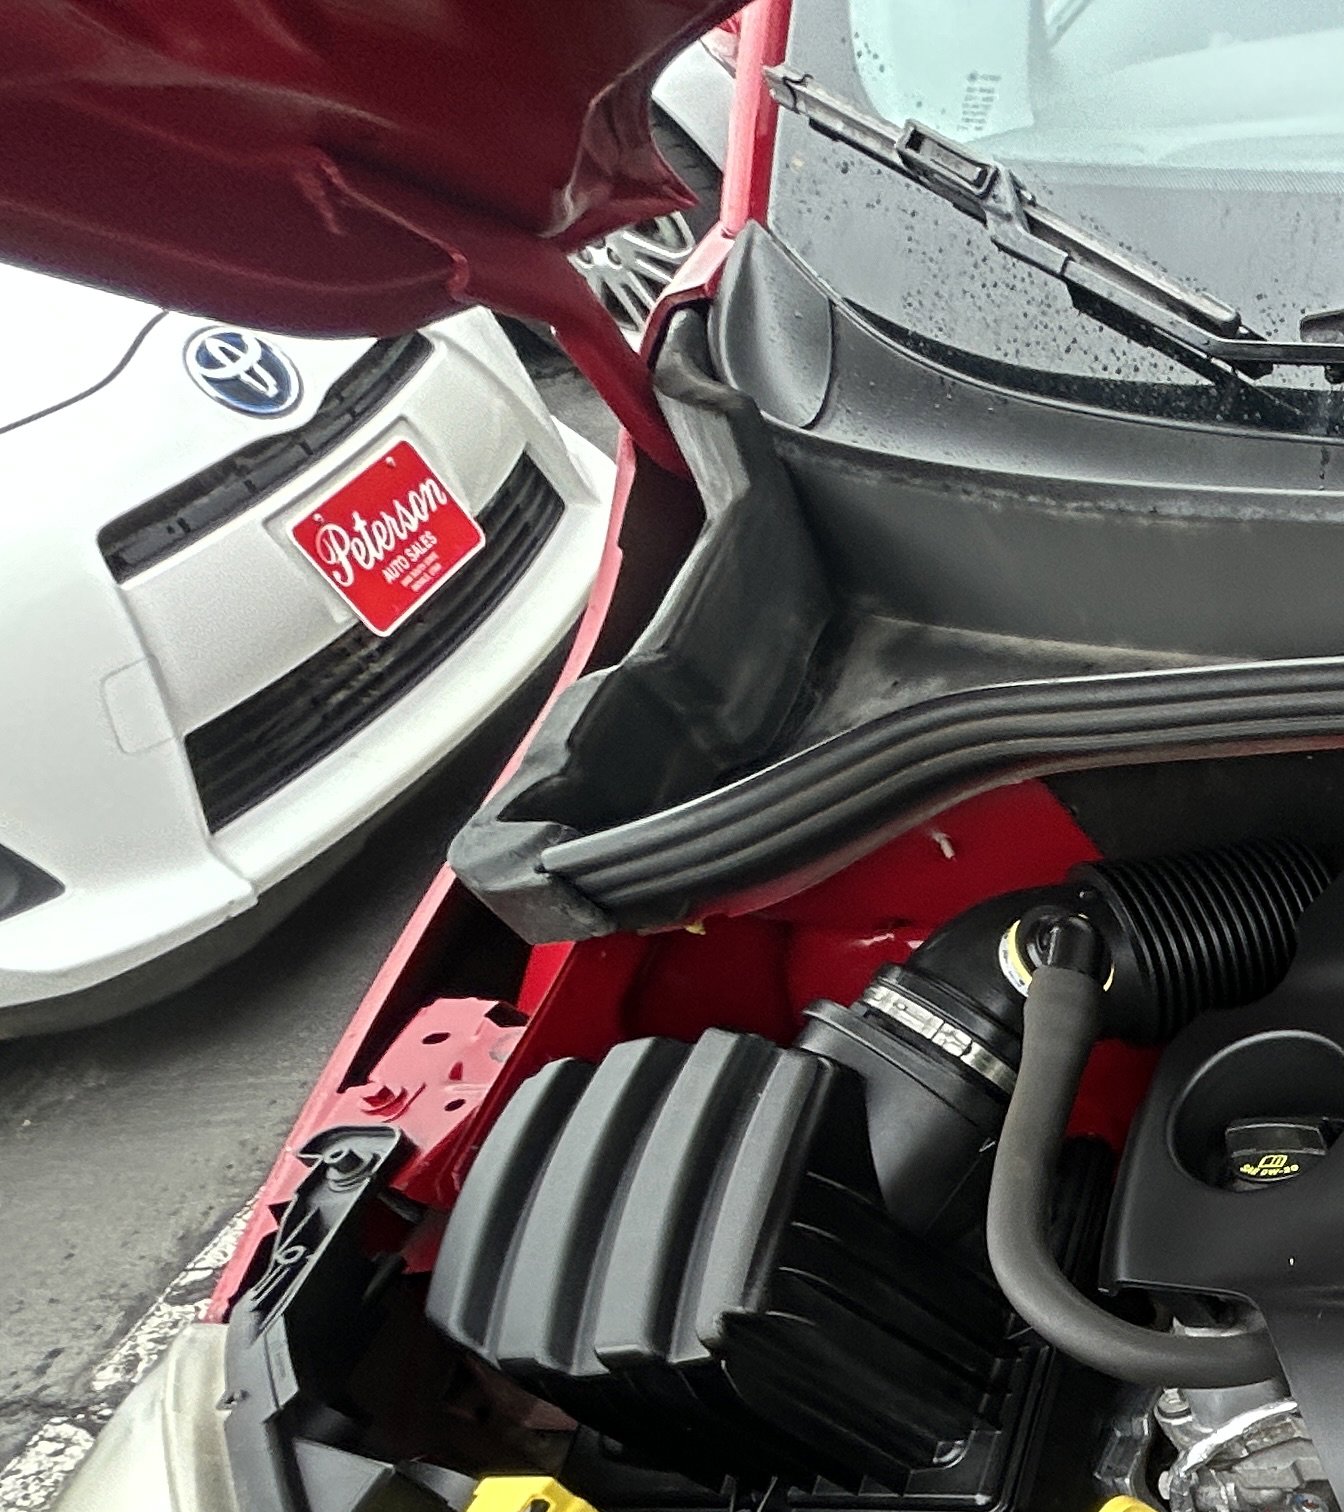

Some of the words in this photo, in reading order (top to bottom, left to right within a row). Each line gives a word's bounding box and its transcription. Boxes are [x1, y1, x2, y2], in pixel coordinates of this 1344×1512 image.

[316, 477, 448, 587] Peterson
[381, 554, 411, 584] AUTO
[404, 530, 438, 562] SALES
